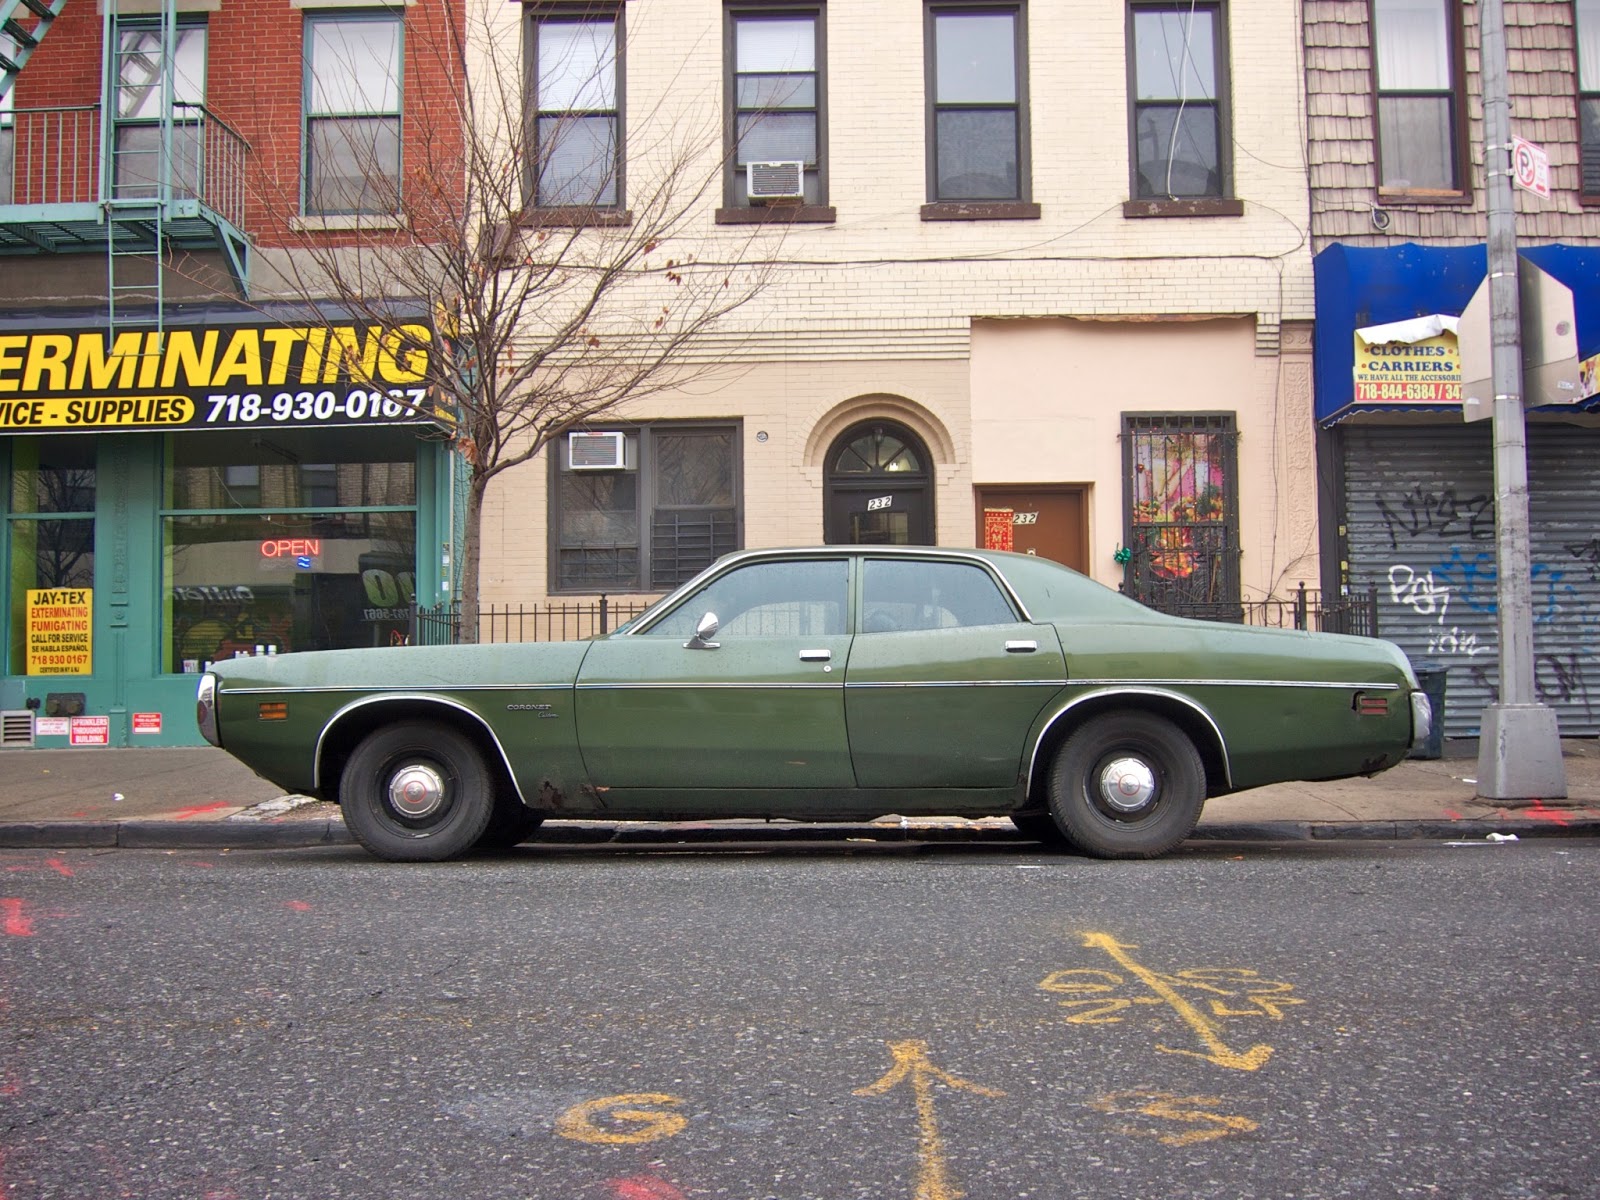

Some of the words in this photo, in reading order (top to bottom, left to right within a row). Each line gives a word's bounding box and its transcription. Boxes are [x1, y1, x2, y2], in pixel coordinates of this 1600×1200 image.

[1370, 345, 1445, 356] CLOTHES
[0, 324, 432, 392] ERMINATING
[1368, 361, 1453, 372] CARRIERS
[1405, 374, 1419, 382] THE
[1358, 384, 1436, 400] 718-844-6384
[206, 388, 427, 422] 718-930-0167
[65, 398, 187, 424] SUPPLIES
[869, 497, 891, 510] 232
[1013, 513, 1036, 524] 232
[261, 538, 320, 557] OPEN
[34, 591, 86, 606] JAY-TEX
[31, 606, 88, 618] EXTERMINATING
[31, 620, 88, 632] FUMIGATING
[31, 634, 47, 643] CALL
[48, 634, 61, 643] FOR
[62, 633, 88, 643] SERVICE
[32, 645, 40, 653] SE
[40, 645, 60, 653] HABLA
[61, 644, 88, 652] ESPAÑOL
[32, 655, 48, 665] 718
[49, 655, 65, 664] 930
[66, 655, 88, 664] 0167
[72, 718, 108, 726] SPRINKLERS
[73, 727, 107, 735] THROUGHOUT
[75, 735, 104, 743] BUILDING
